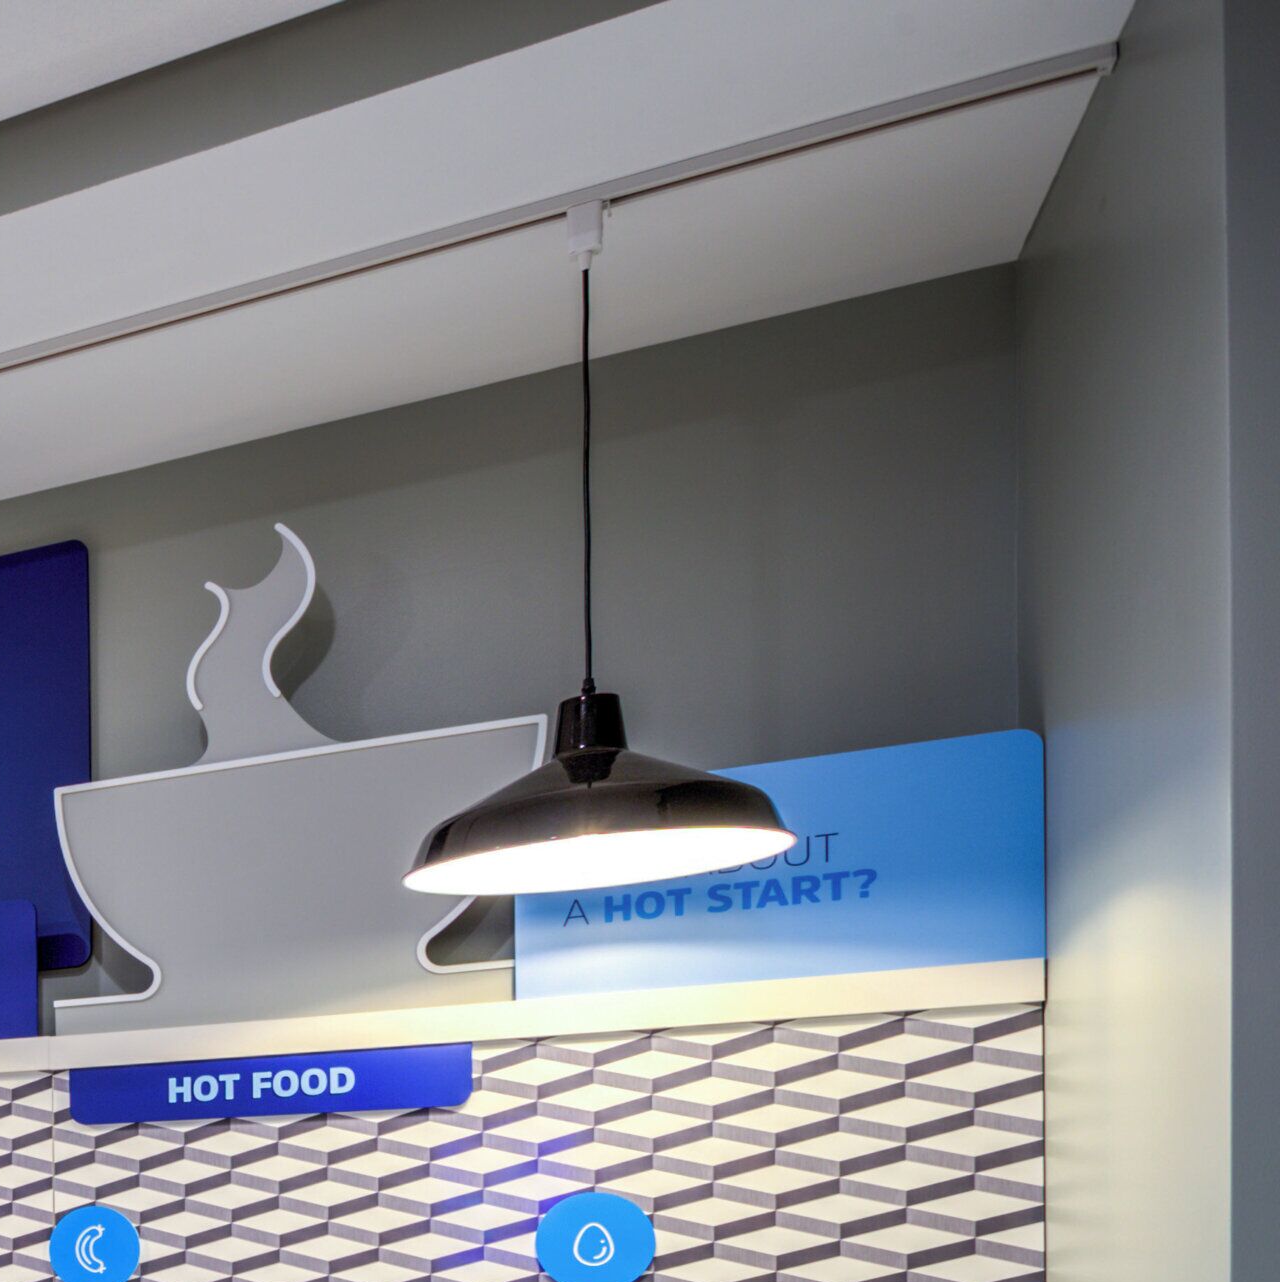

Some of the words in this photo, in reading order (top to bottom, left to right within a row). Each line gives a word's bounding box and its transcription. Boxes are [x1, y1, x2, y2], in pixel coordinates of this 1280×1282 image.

[563, 899, 590, 927] A
[603, 888, 692, 923] HOT
[707, 869, 878, 913] START?
[168, 1073, 240, 1103] HOT
[252, 1066, 356, 1099] FOOD
